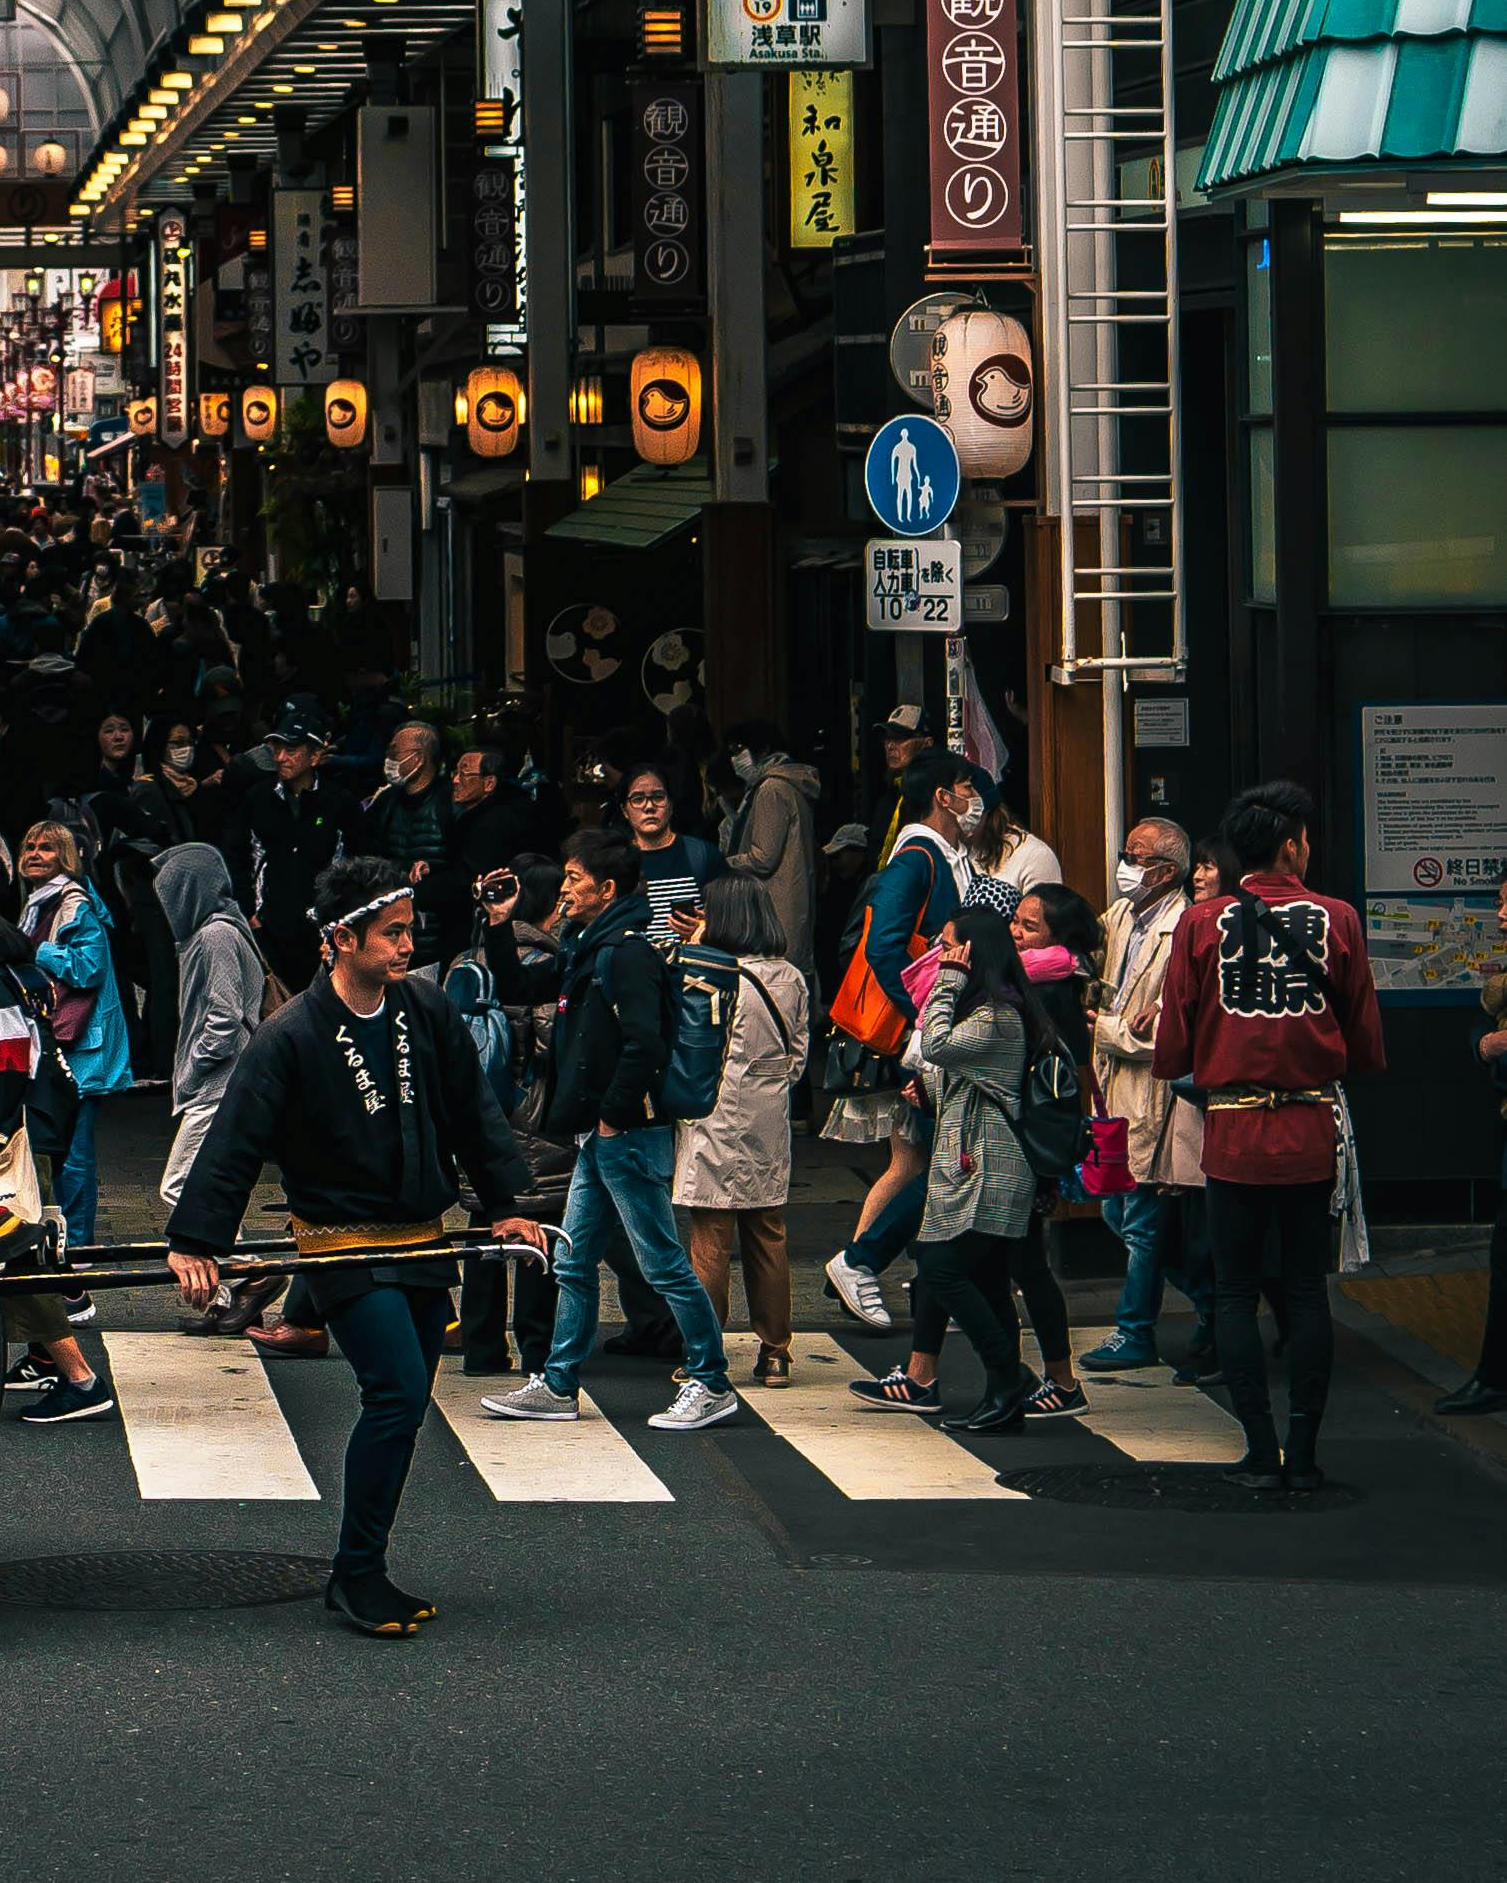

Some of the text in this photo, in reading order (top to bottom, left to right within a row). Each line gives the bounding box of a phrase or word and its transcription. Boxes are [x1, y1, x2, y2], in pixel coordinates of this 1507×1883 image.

[754, 1, 771, 13] 19
[751, 25, 821, 47] 浅草駅
[749, 47, 798, 59] Asakusa
[802, 104, 842, 232] 和泉屋
[644, 100, 689, 282] 観音通り
[873, 548, 914, 570] 自転車
[873, 571, 914, 594] 人力車
[921, 561, 954, 583] を除く
[1446, 858, 1507, 876] 終日禁
[1454, 877, 1467, 886] No
[395, 1010, 415, 1104] くるま屋
[335, 1024, 386, 1115] くるま屋
